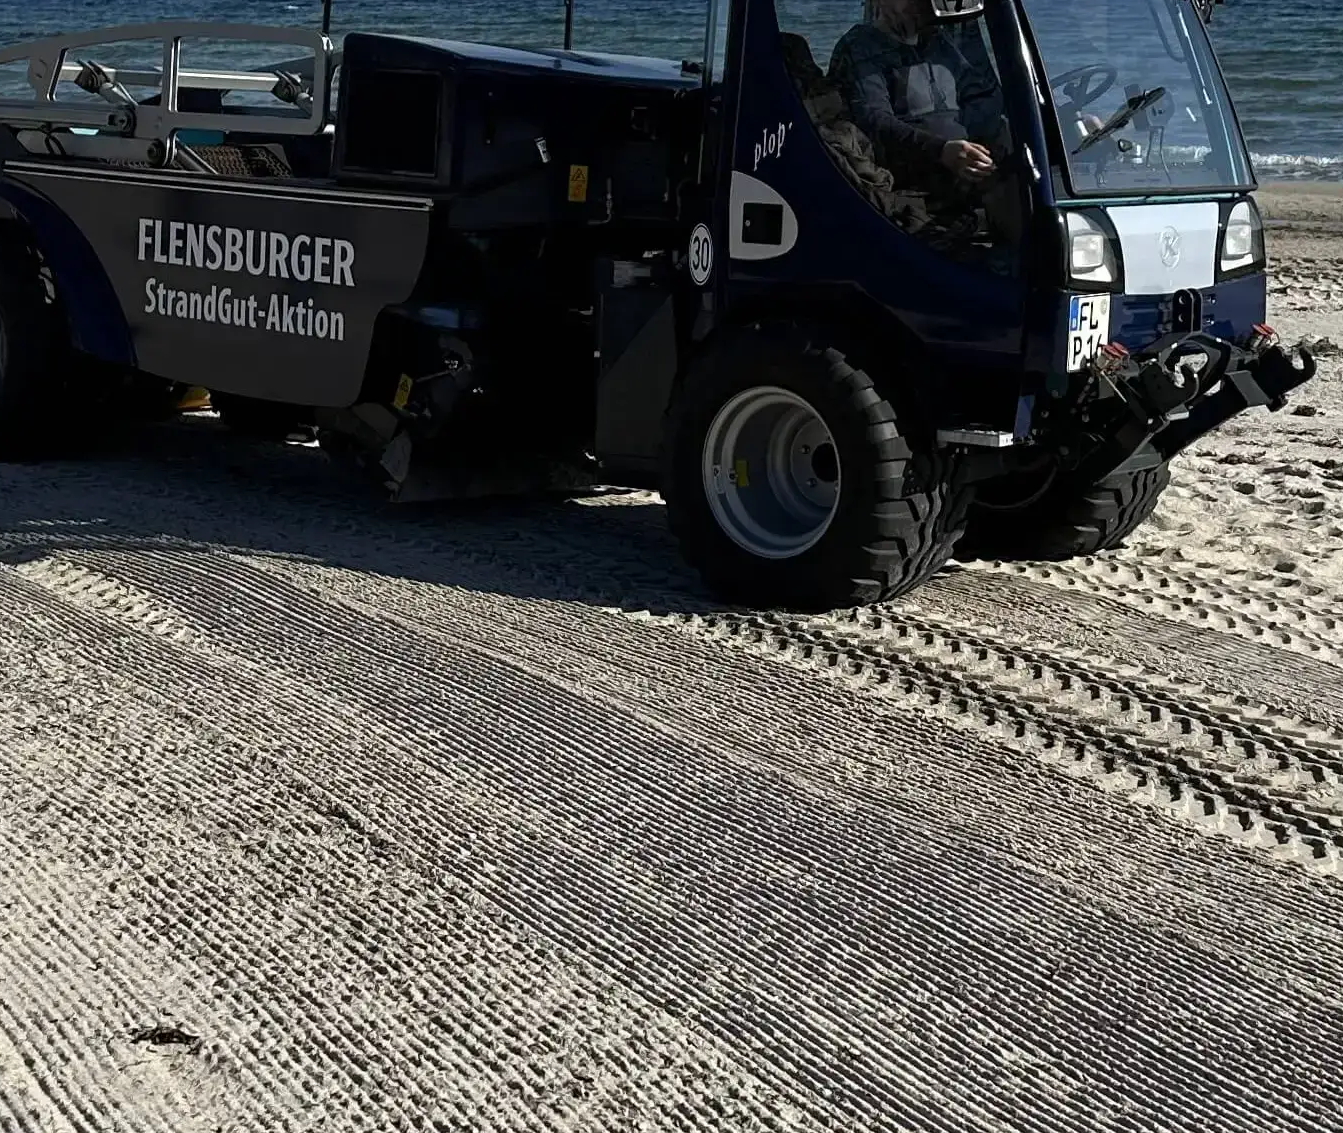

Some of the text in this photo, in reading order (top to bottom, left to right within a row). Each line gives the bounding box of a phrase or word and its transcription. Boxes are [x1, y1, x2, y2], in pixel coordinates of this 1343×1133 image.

[138, 218, 356, 287] FLENSBURGER
[692, 238, 709, 273] 30
[144, 277, 344, 342] StrandGut-Aktion
[1079, 301, 1099, 331] FL
